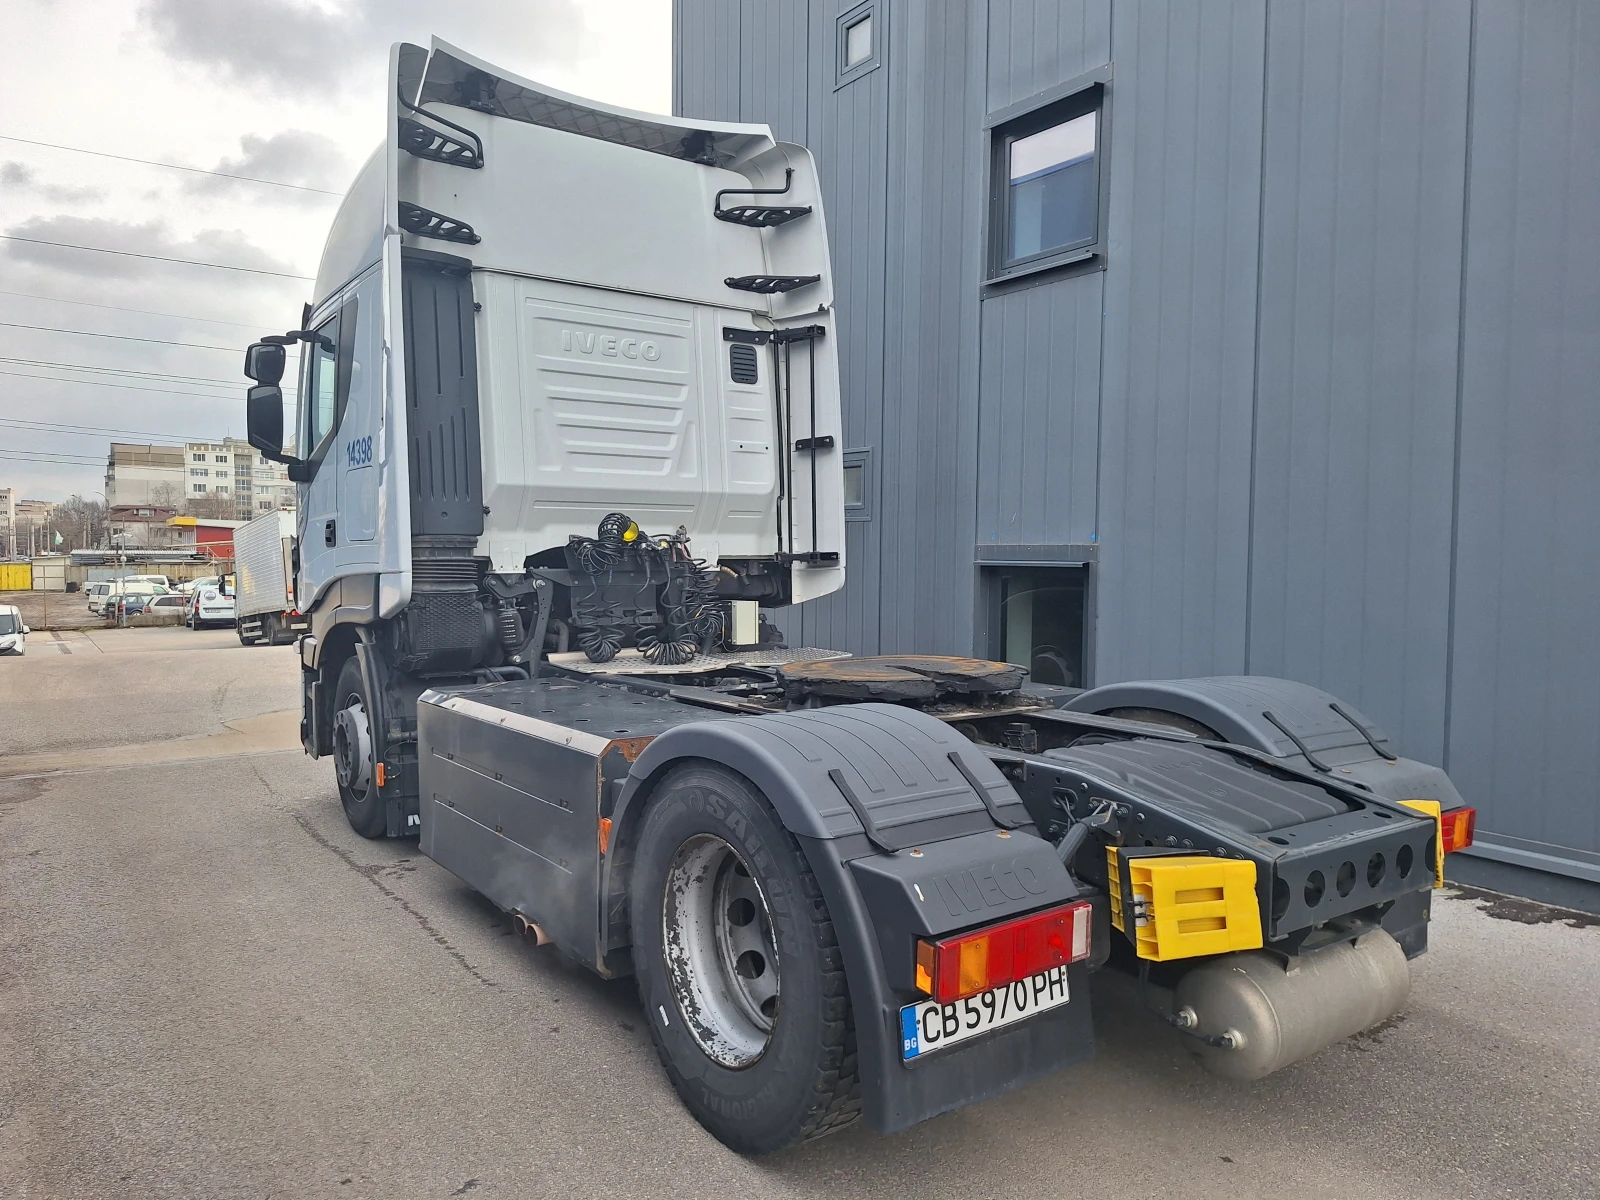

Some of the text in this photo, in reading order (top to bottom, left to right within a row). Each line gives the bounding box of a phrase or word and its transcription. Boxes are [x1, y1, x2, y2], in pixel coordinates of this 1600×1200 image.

[561, 329, 661, 362] IVECO
[346, 435, 373, 467] 14398
[706, 794, 800, 957] SAILUN
[932, 857, 1048, 917] IVECO
[965, 983, 1028, 1029] 5970
[1032, 966, 1064, 1007] PH
[903, 1037, 917, 1051] BG
